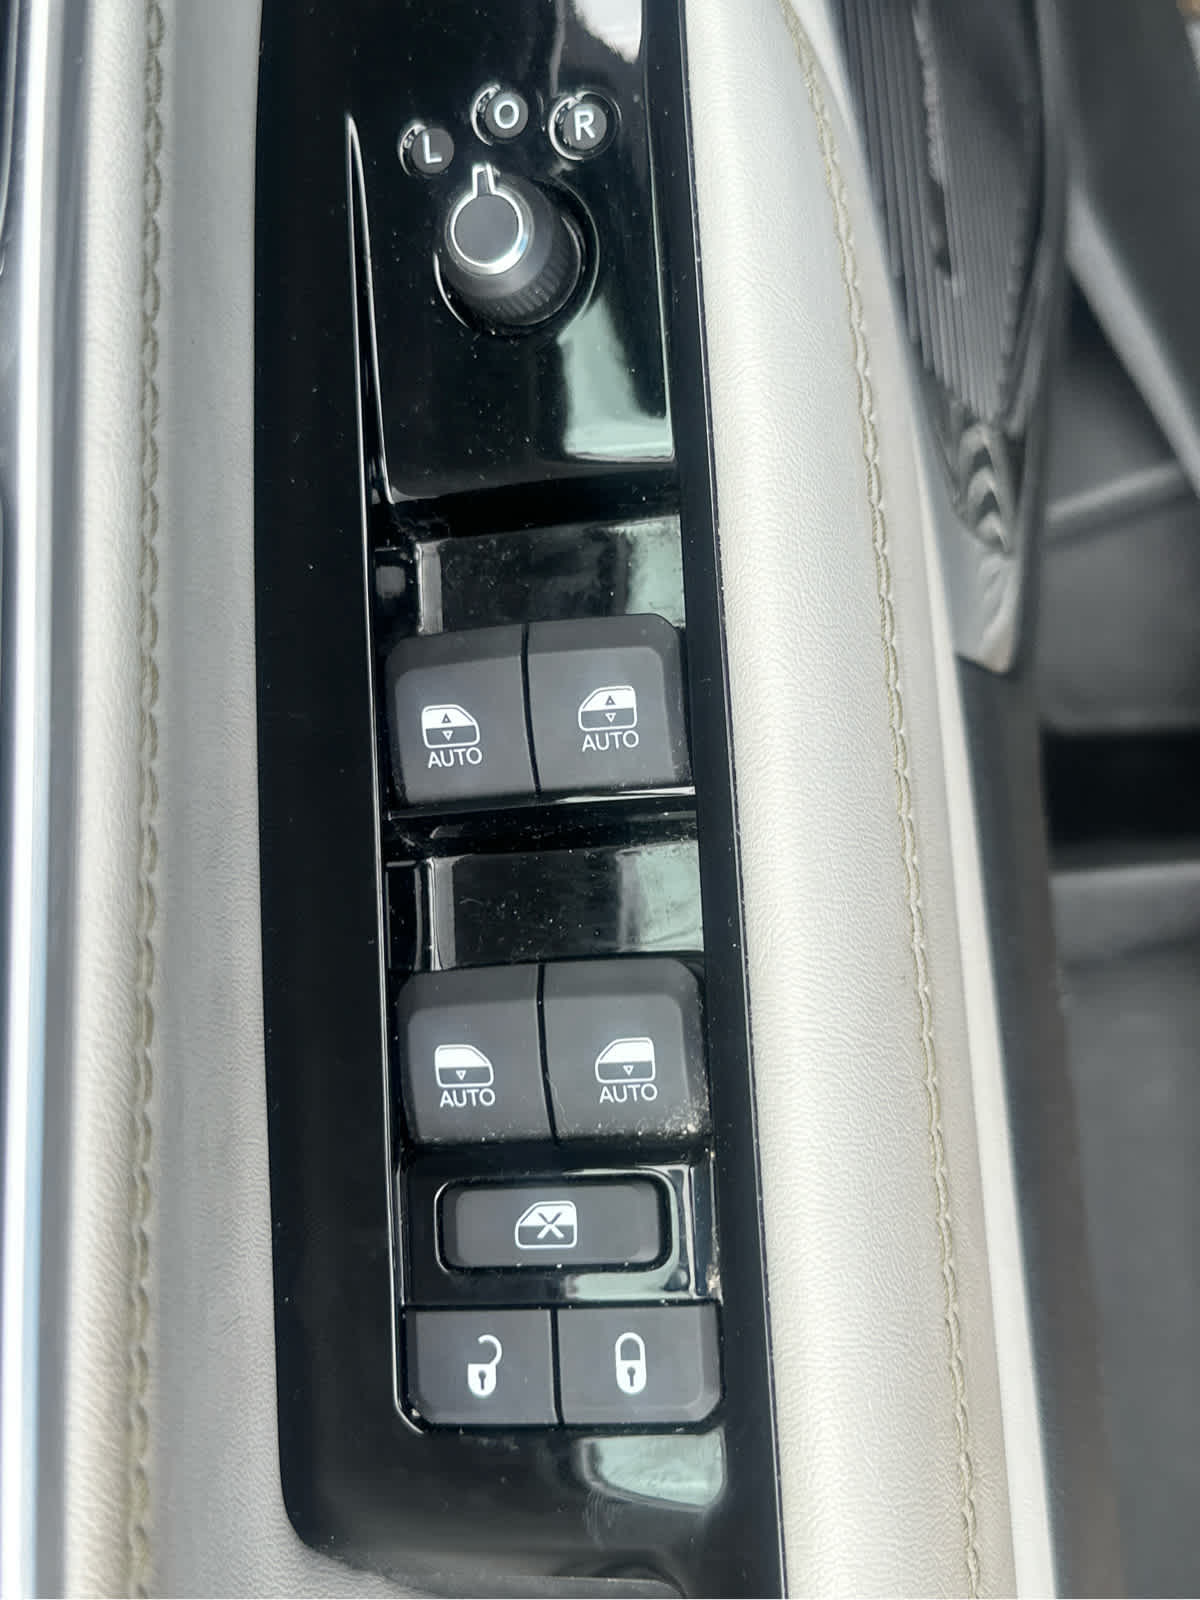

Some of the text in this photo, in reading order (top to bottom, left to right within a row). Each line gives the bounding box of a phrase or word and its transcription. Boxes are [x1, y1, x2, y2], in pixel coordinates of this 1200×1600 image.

[494, 100, 520, 129] O
[574, 110, 596, 141] R
[423, 132, 442, 164] L
[582, 730, 639, 752] AUTO
[427, 747, 483, 768] AUTO
[439, 1087, 496, 1108] AUTO
[599, 1083, 658, 1104] AUTO
